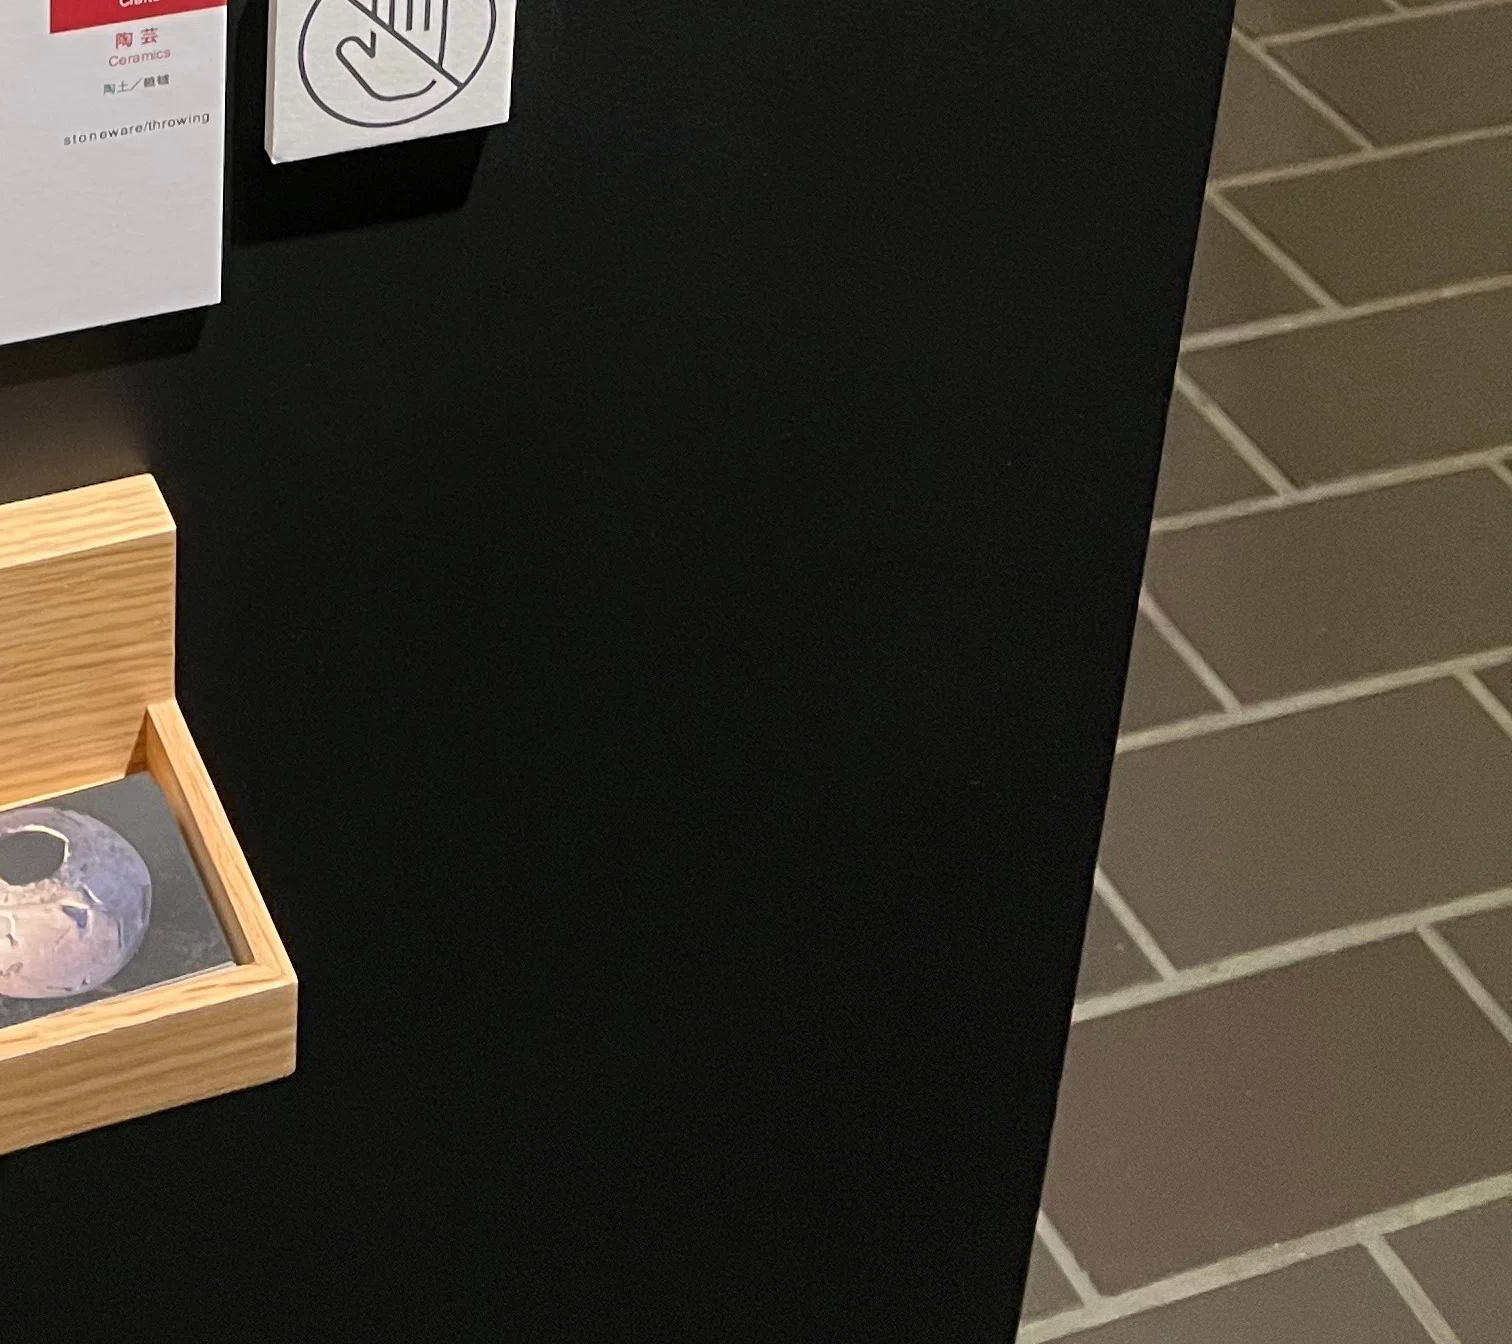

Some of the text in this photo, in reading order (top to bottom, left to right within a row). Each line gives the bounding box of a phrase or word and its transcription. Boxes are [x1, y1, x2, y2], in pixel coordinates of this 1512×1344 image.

[115, 27, 159, 50] 陶芸
[108, 49, 171, 67] Ceramics
[63, 112, 210, 146] stoneware/throwing
